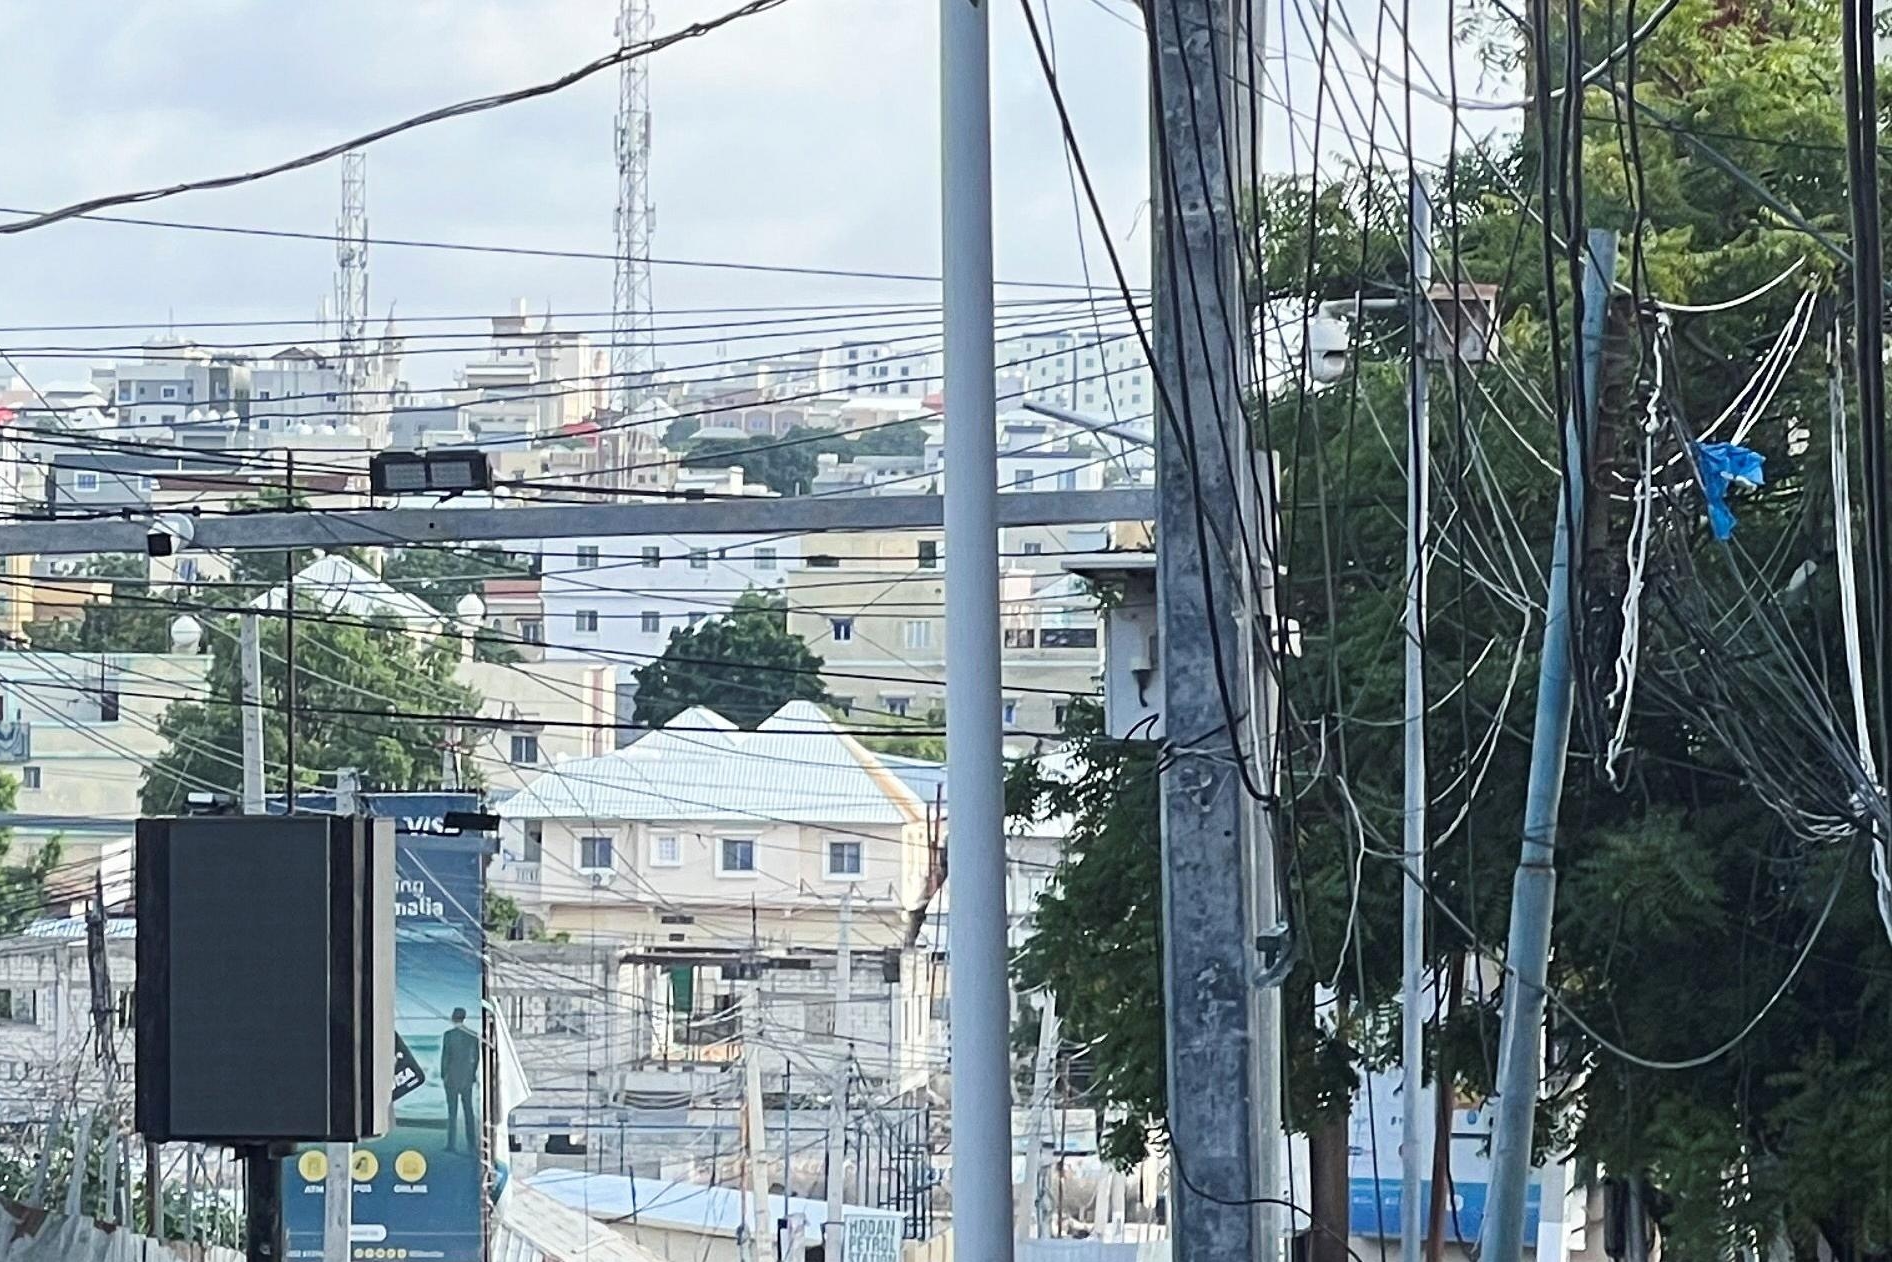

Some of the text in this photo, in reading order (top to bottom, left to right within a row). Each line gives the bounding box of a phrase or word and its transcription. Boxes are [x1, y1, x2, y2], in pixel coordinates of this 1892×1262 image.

[403, 816, 460, 836] VIS
[848, 1218, 896, 1236] HODAN
[848, 1236, 896, 1251] PETROL
